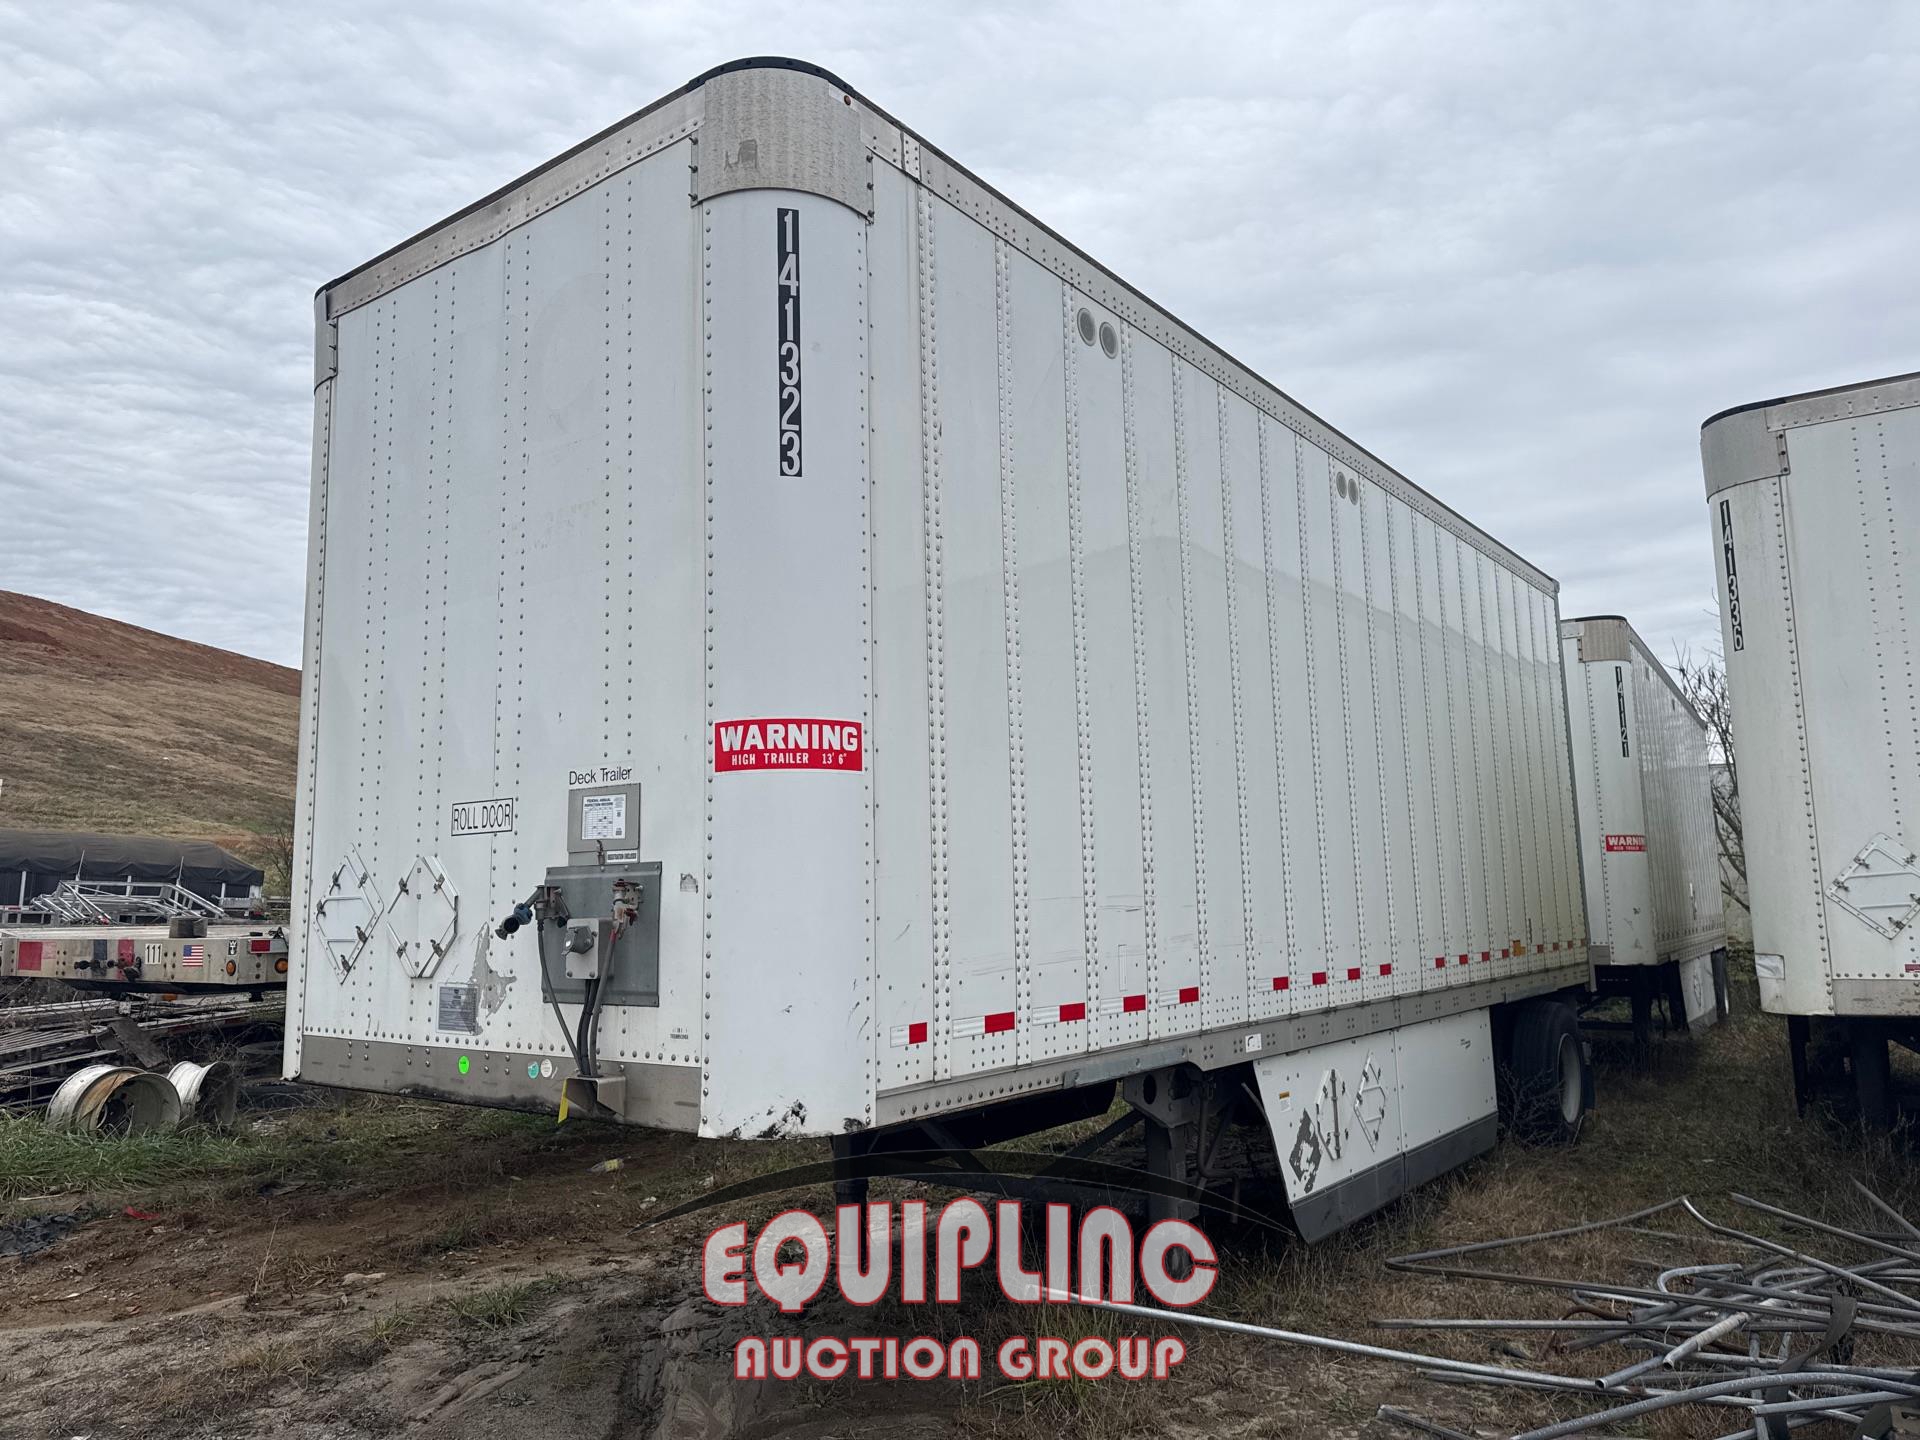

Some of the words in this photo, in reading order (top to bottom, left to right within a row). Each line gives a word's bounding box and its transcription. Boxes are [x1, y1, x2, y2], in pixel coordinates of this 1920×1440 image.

[778, 210, 801, 476] 141323
[1721, 501, 1743, 650] 141336
[719, 723, 858, 752] WARNING
[731, 753, 756, 766] HIGH
[764, 752, 809, 765] TRAILER
[569, 769, 597, 785] Deck
[600, 766, 632, 782] Trailer
[453, 807, 478, 831] ROLL
[482, 803, 511, 829] DOOR
[146, 944, 161, 964] 111
